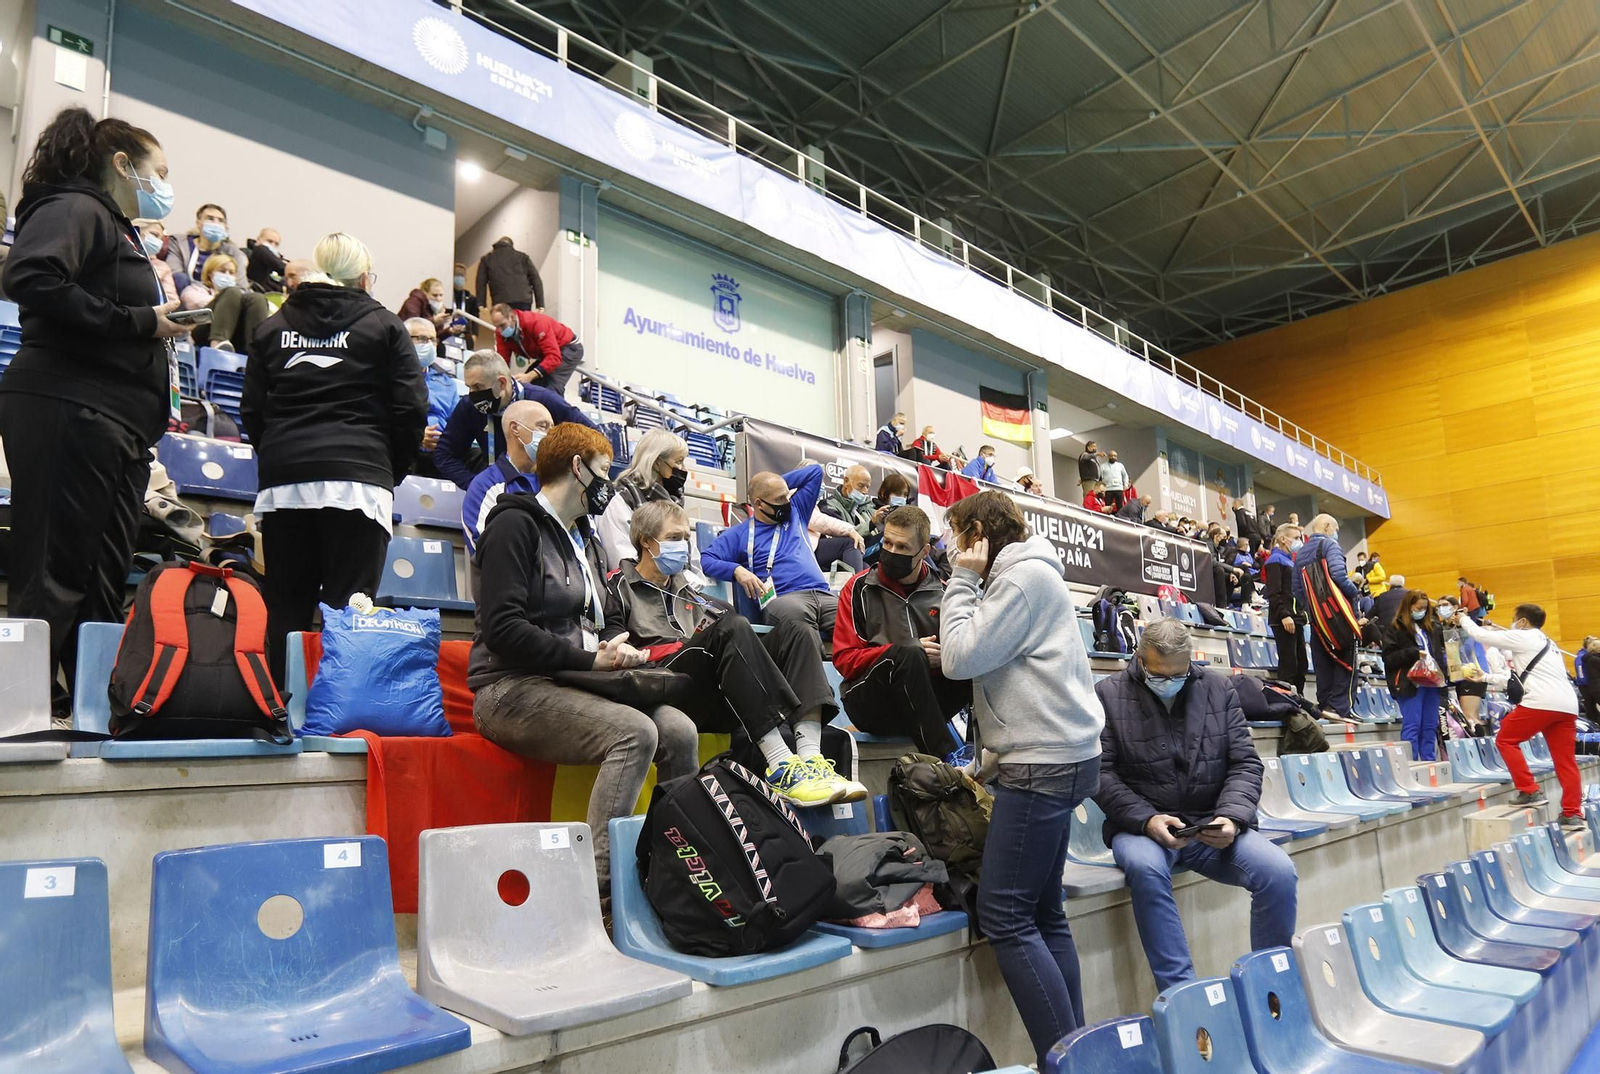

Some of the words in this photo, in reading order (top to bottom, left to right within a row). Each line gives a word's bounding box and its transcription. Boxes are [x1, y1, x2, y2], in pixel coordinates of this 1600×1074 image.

[280, 330, 350, 349] DENMARK
[743, 348, 762, 367] de
[765, 353, 816, 385] Huelva
[1057, 547, 1092, 569] PAÑA
[1, 627, 11, 638] 3
[551, 833, 560, 844] 5
[337, 849, 349, 862] 4
[43, 875, 58, 890] 3
